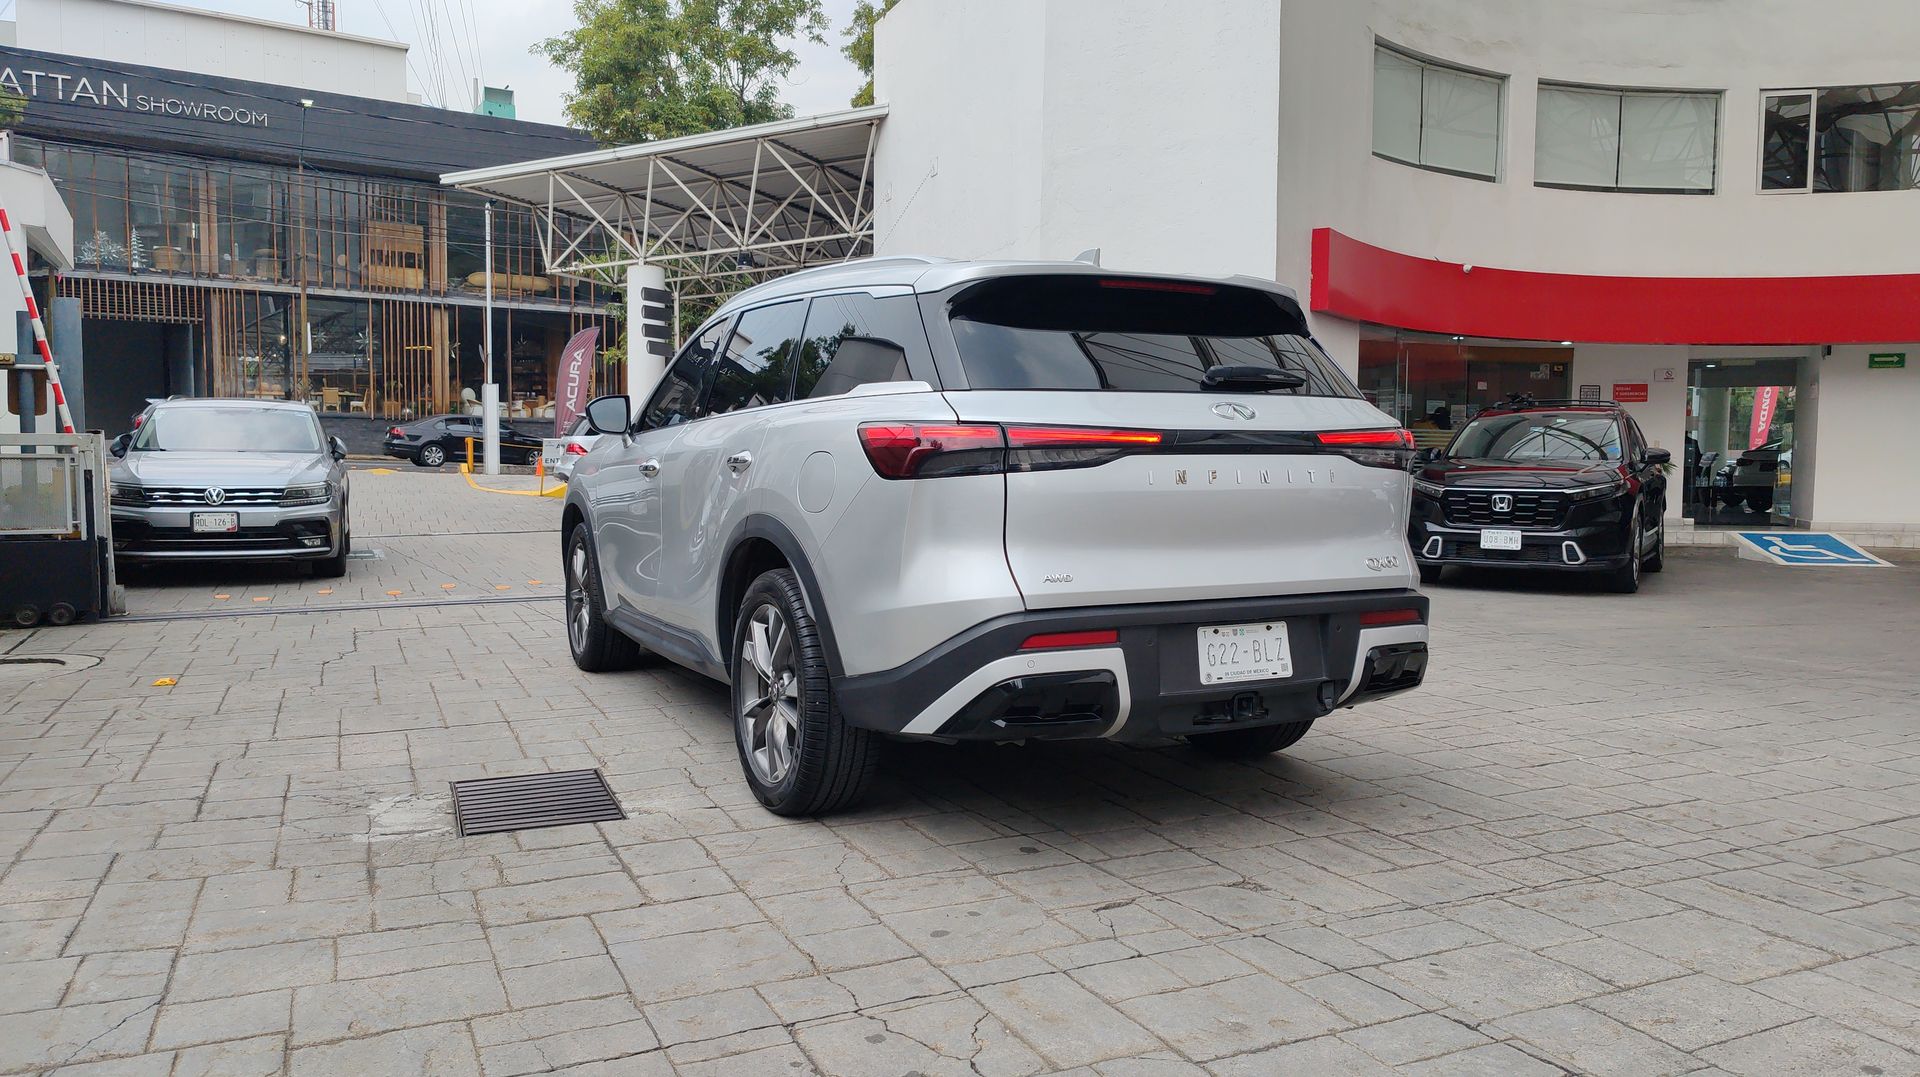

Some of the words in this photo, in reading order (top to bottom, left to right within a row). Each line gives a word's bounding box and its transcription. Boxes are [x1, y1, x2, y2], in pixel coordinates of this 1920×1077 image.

[0, 67, 128, 108] ATTAN
[136, 95, 268, 127] SHOWROOM
[566, 348, 585, 412] ACURA
[1042, 574, 1073, 584] AWD
[1364, 556, 1399, 572] QX60
[1207, 637, 1285, 667] G22-BLZ
